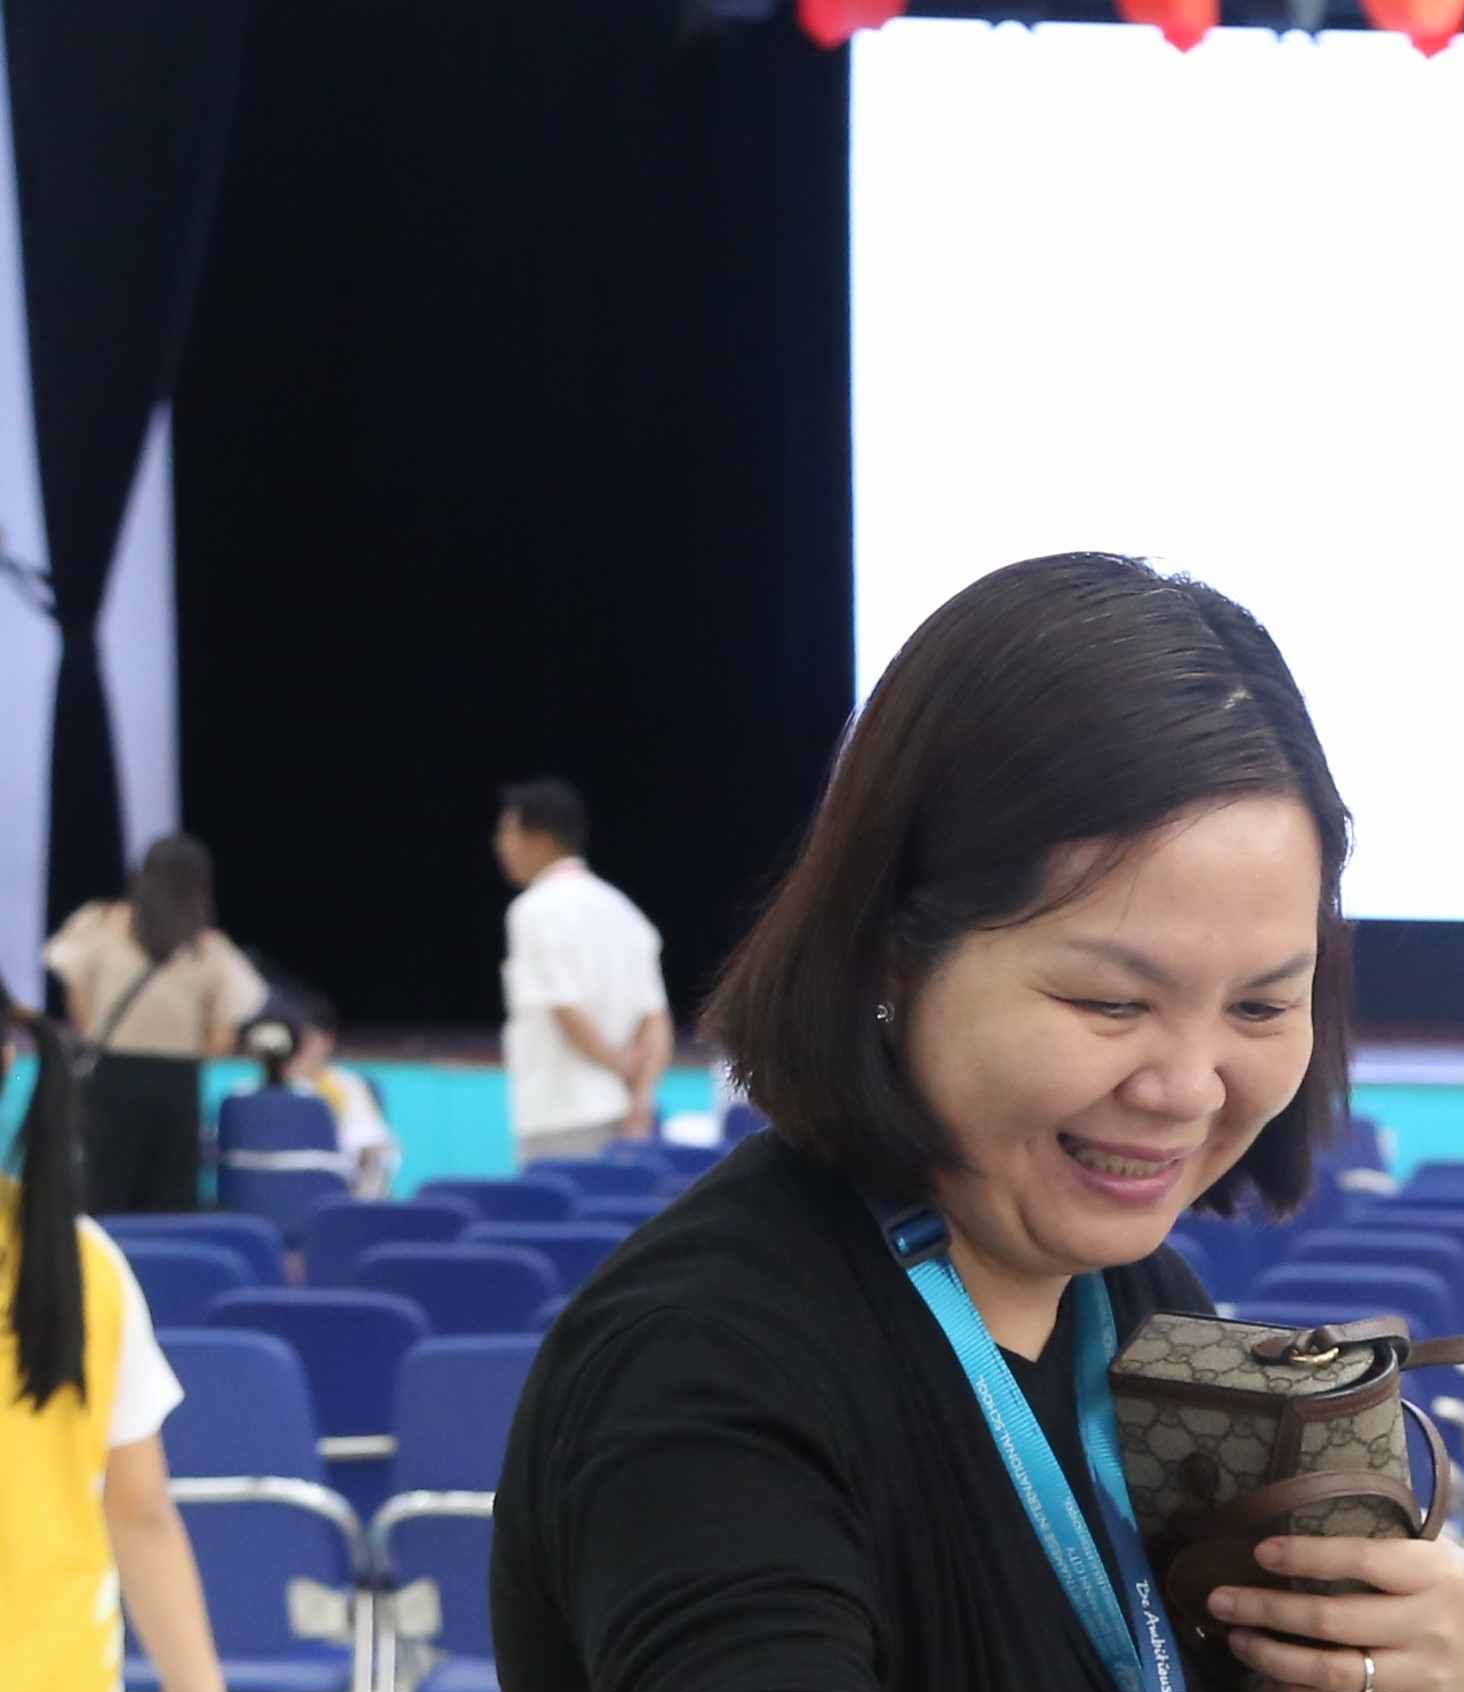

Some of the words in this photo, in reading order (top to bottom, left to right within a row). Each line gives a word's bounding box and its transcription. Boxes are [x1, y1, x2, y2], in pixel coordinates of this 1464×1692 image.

[974, 1375, 1008, 1434] SCHOOL
[1003, 1433, 1050, 1532] INTERNATIONAL
[1135, 1580, 1150, 1608] Be
